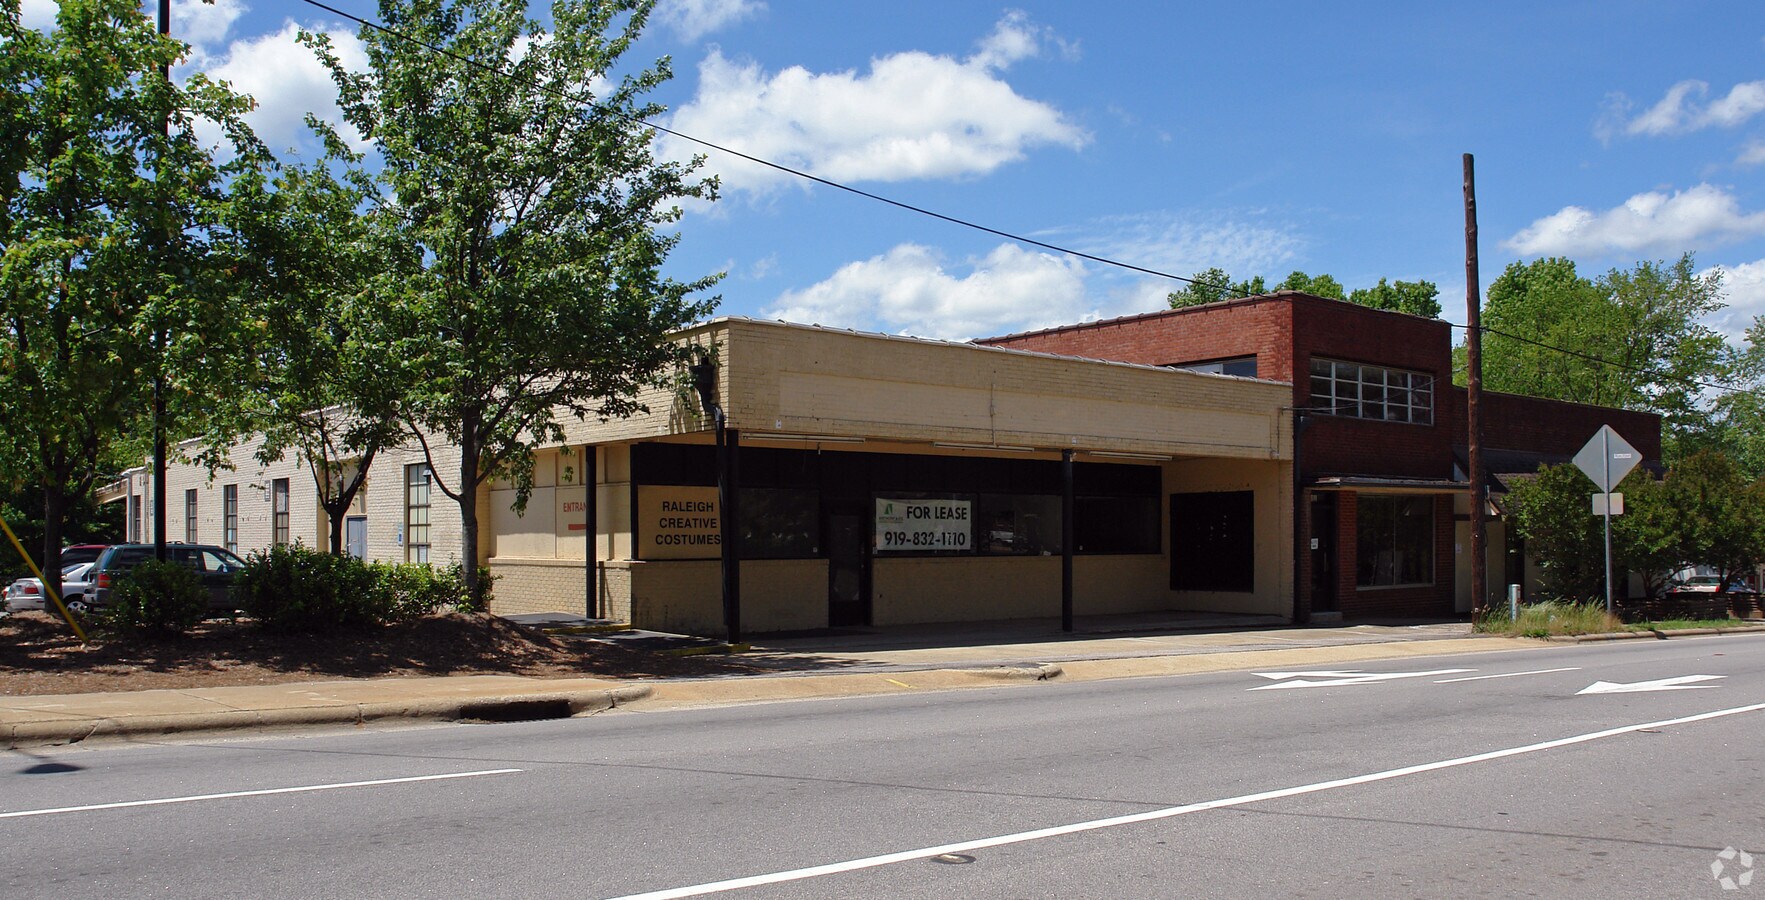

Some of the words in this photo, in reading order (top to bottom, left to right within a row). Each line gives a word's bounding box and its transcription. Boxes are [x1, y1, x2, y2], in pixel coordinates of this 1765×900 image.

[662, 501, 714, 512] RALEIGH
[906, 506, 931, 519] FOR
[934, 506, 967, 520] LEASE
[659, 517, 718, 529] CREATIVE
[655, 534, 721, 545] COSTUMES
[884, 531, 966, 546] 919-832-1110
